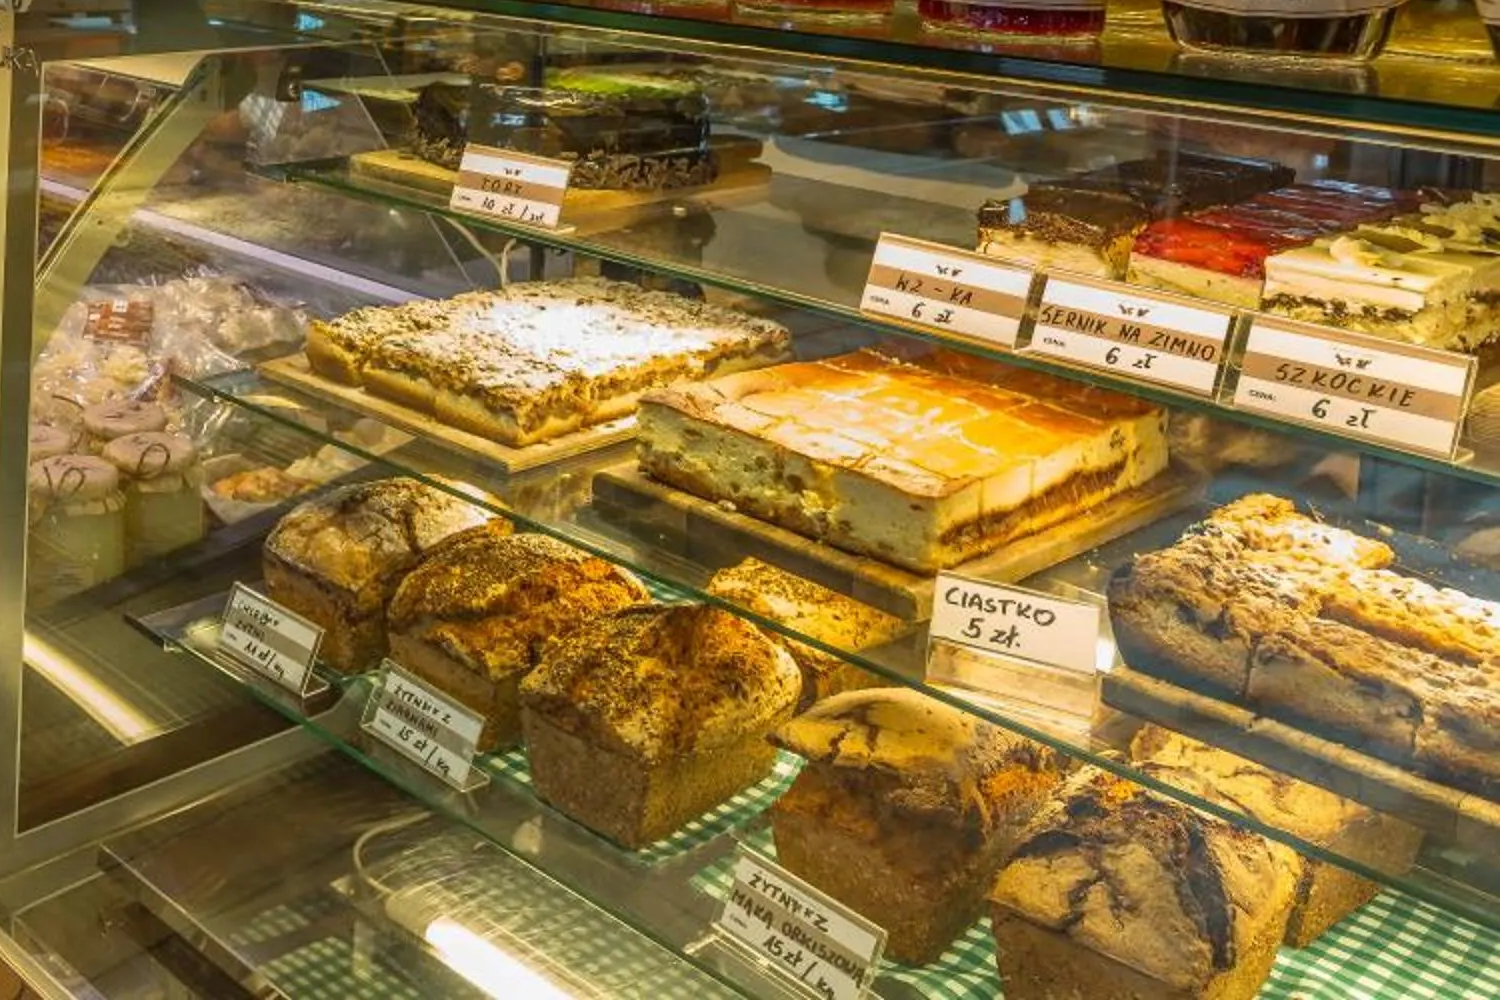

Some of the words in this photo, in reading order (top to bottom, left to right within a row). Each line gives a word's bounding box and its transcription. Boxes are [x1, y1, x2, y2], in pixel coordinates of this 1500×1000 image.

[911, 301, 926, 319] 6
[1039, 305, 1106, 335] SERNIK
[1119, 323, 1142, 341] NA
[1149, 331, 1215, 361] ZIMNO
[1104, 347, 1120, 366] 6
[1311, 398, 1331, 420] 6
[945, 587, 1057, 627] CIASTKO
[961, 617, 985, 639] 5
[762, 935, 785, 957] 15
